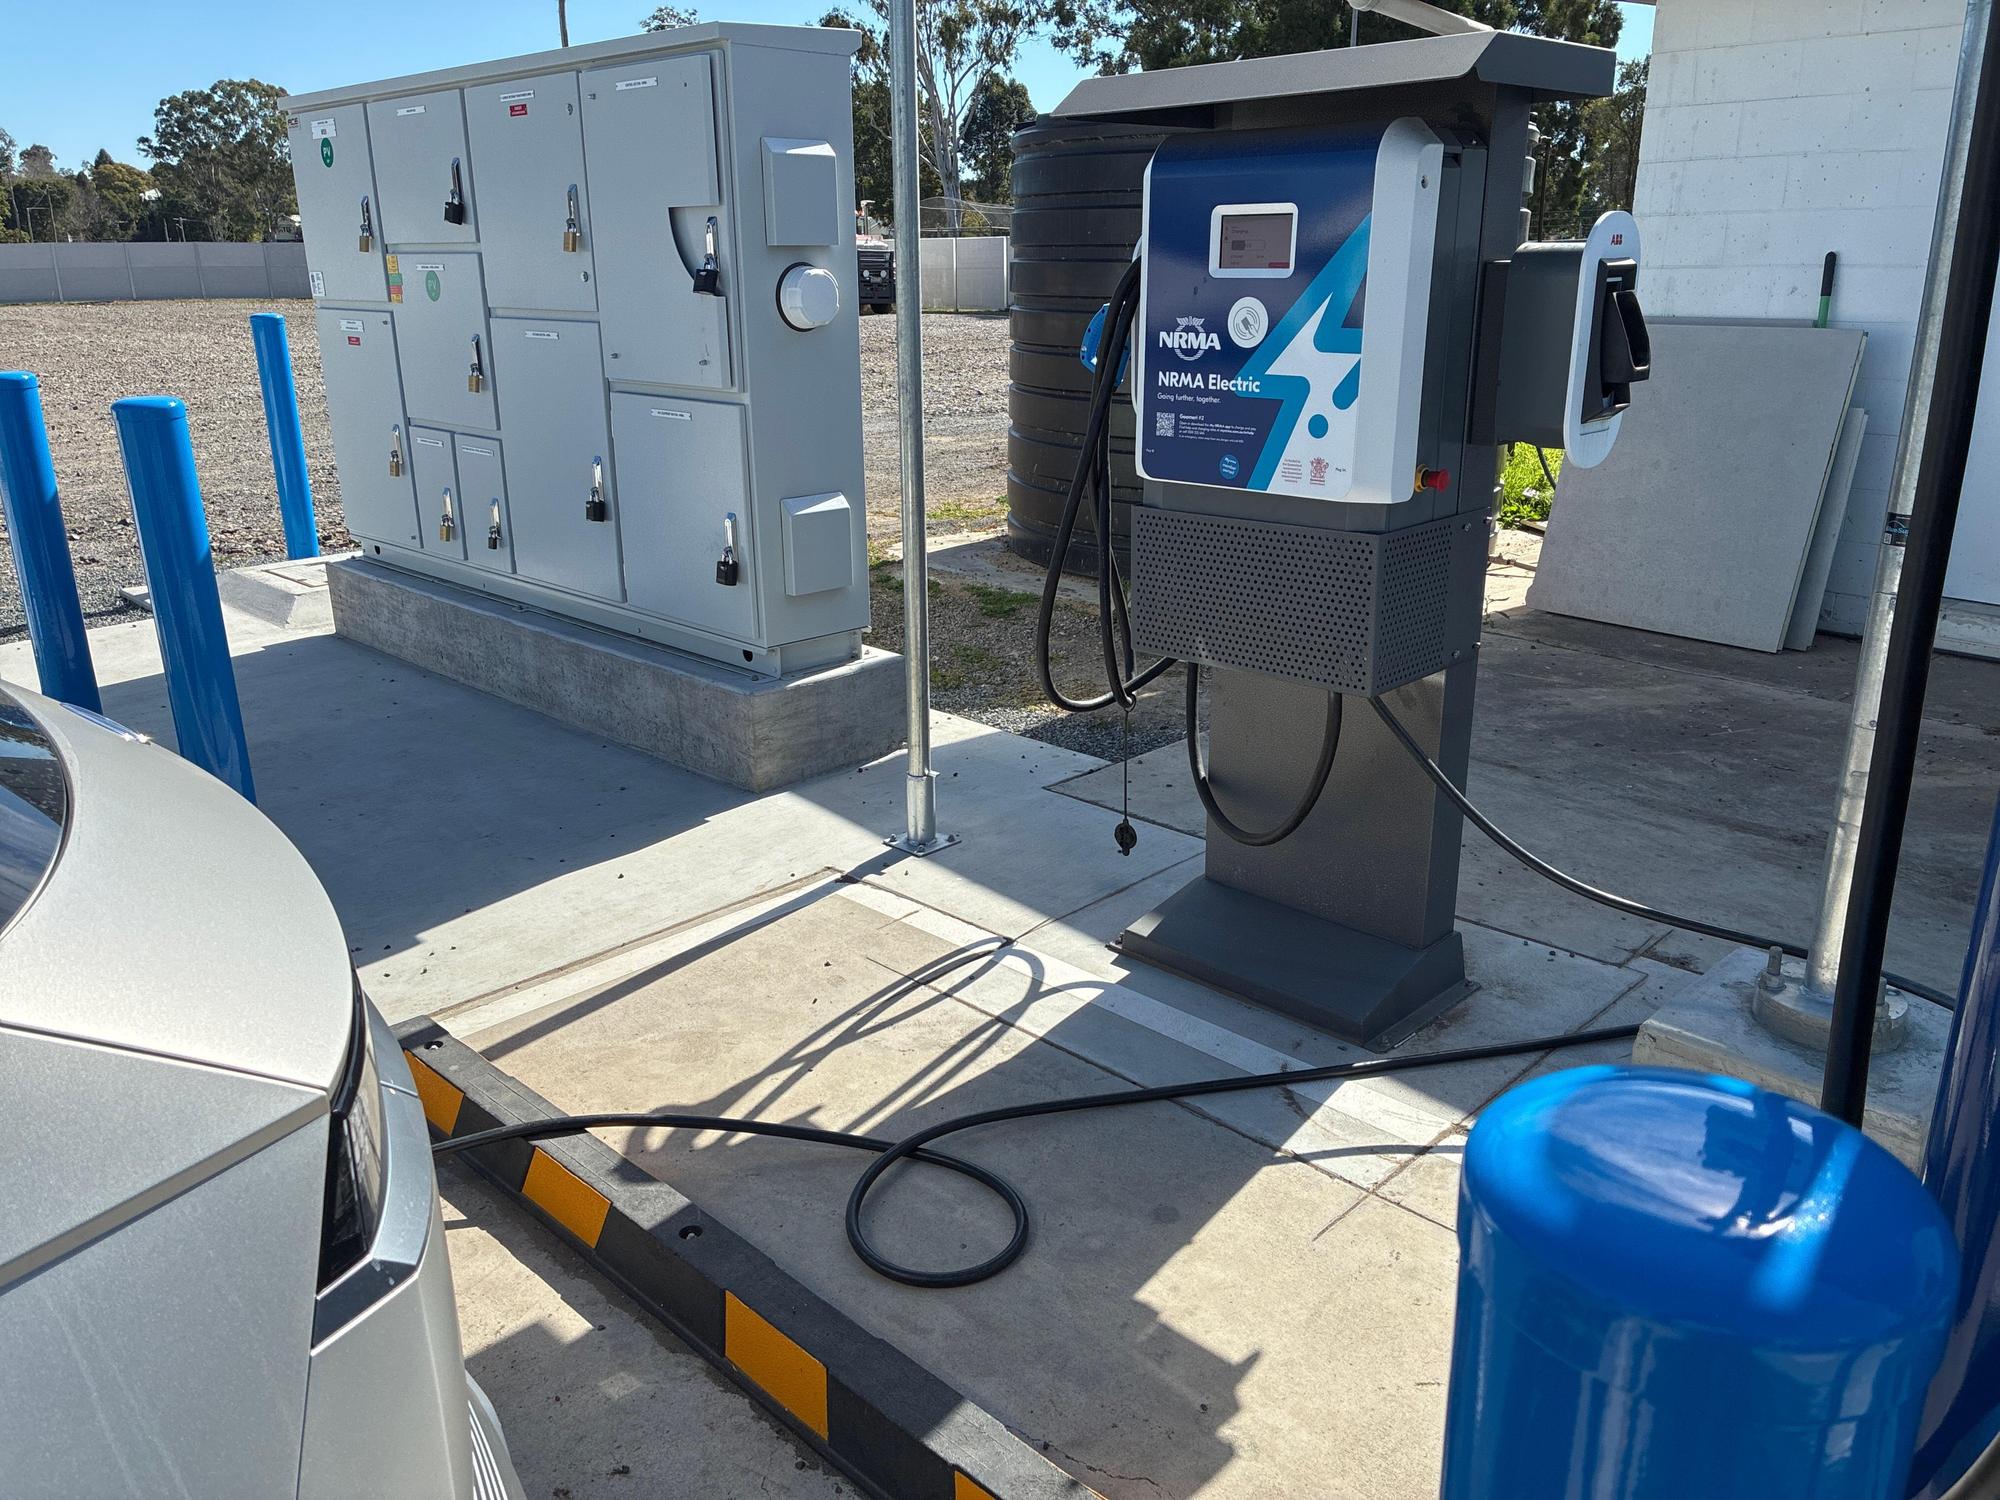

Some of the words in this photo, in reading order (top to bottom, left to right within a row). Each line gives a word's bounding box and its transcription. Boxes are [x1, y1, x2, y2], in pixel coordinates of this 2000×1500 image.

[1610, 233, 1623, 246] ABB
[1159, 331, 1222, 351] NRMA
[1158, 370, 1205, 389] NRMA
[1208, 373, 1261, 393] Electric
[1157, 392, 1175, 402] Going
[1175, 394, 1195, 403] further,
[1196, 395, 1222, 405] together.
